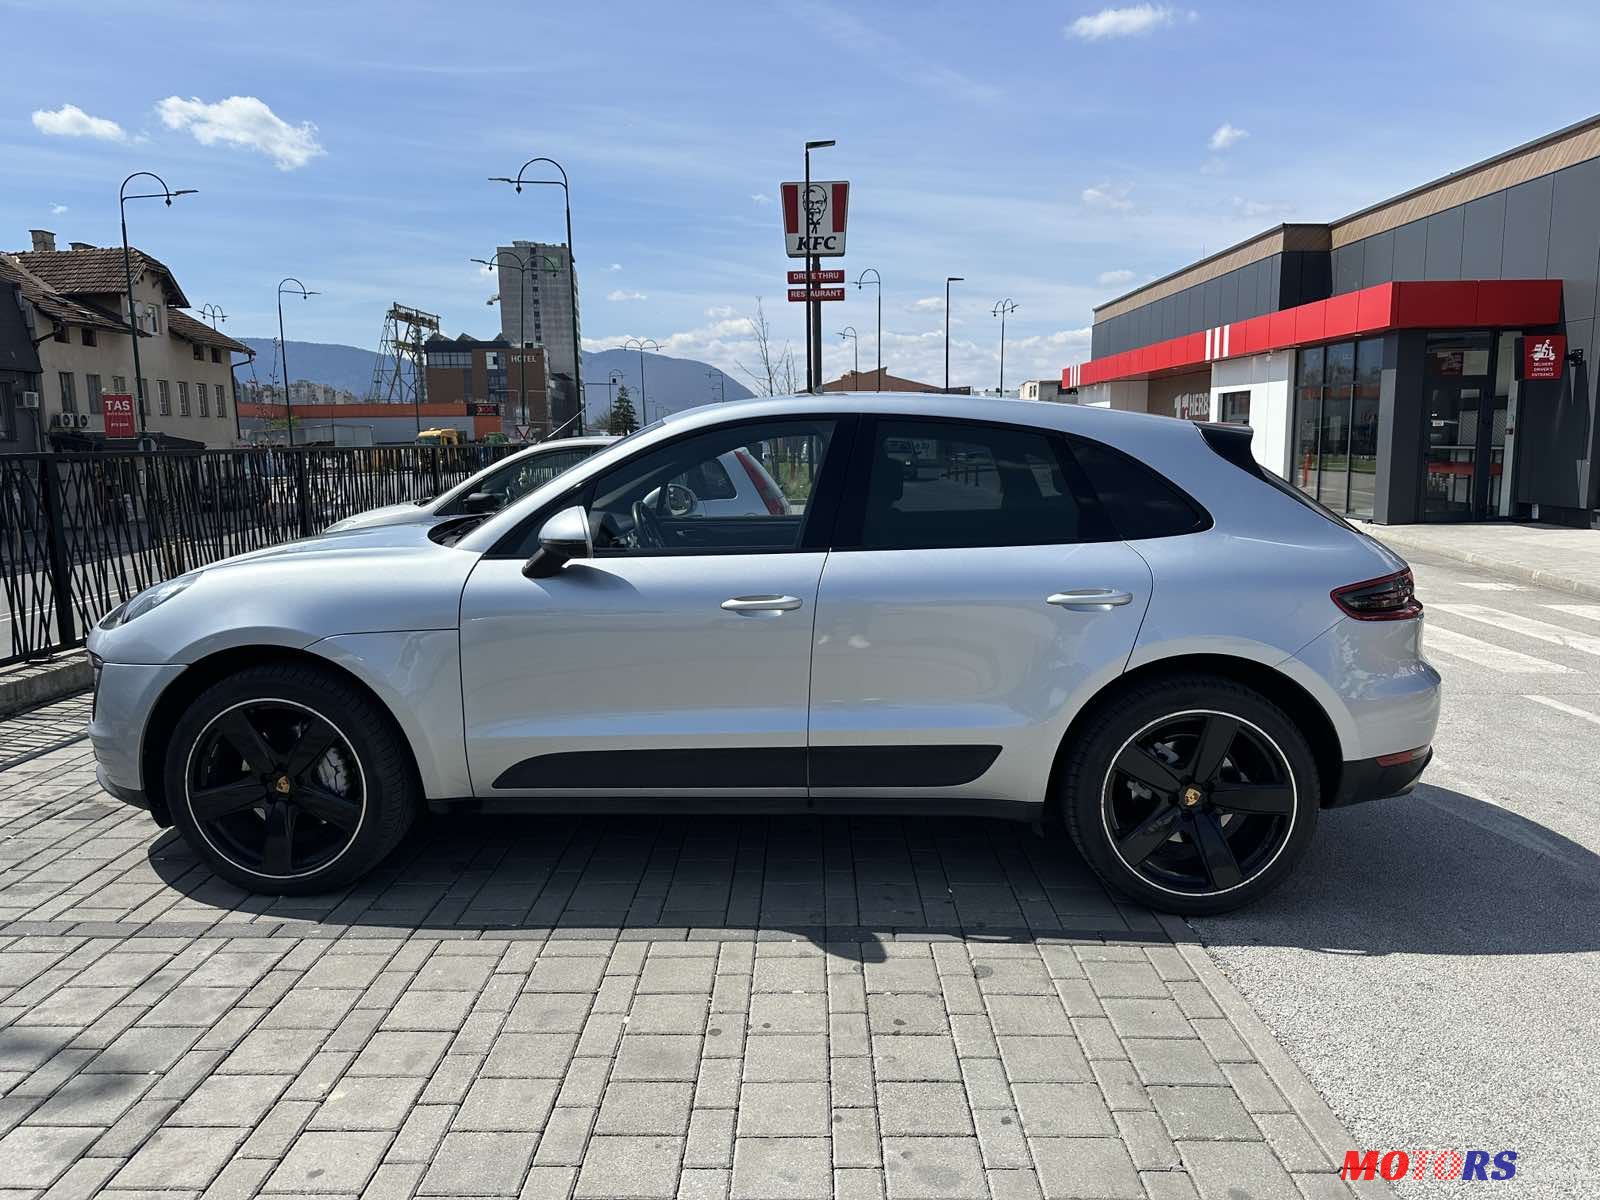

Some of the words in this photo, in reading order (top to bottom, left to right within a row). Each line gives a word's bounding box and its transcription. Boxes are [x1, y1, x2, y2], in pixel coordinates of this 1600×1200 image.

[796, 236, 837, 250] KFC
[817, 271, 839, 279] THRU
[790, 289, 842, 298] RESAURANT
[105, 400, 130, 411] TAS
